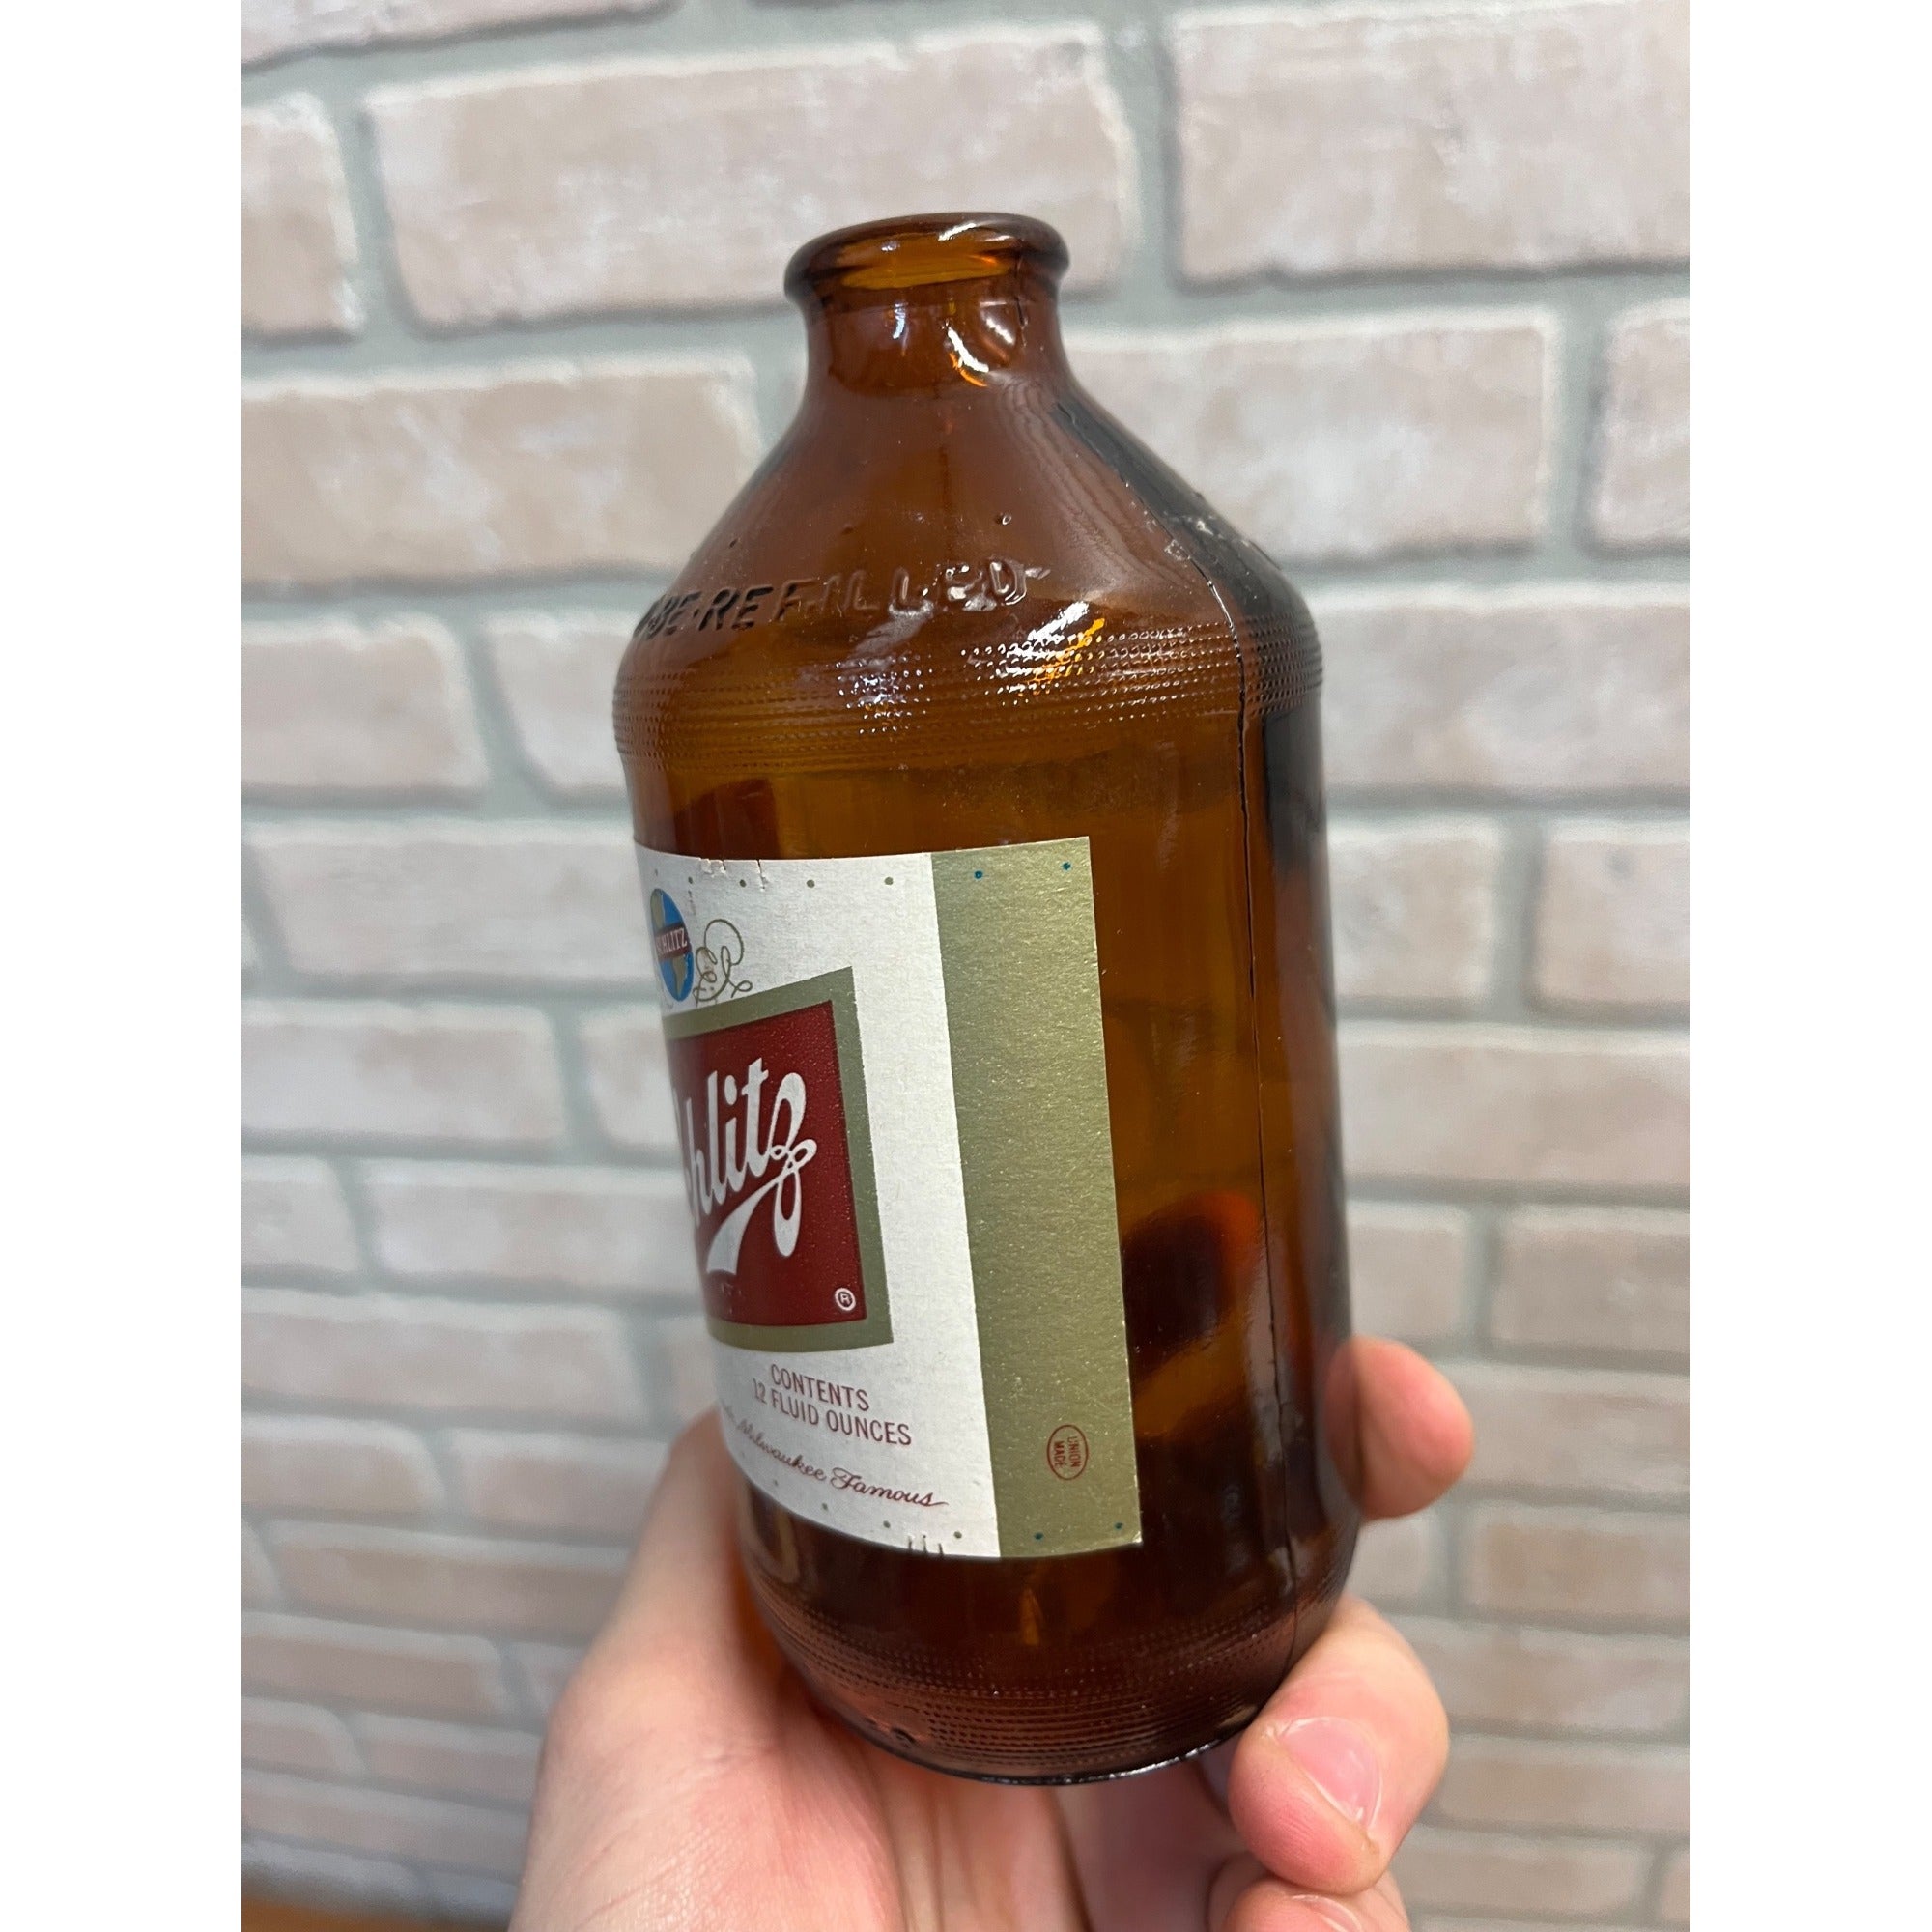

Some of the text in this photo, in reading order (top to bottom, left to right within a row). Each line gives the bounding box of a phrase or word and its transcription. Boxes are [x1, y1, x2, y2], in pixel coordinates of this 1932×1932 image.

[771, 1363, 870, 1412] CONTENTS
[753, 1378, 768, 1404] 12
[771, 1388, 820, 1426] FLUID
[826, 1409, 912, 1446] OUNCES
[1054, 1440, 1067, 1468] MADE
[1067, 1435, 1081, 1467] UNION
[830, 1466, 950, 1508] Famous
